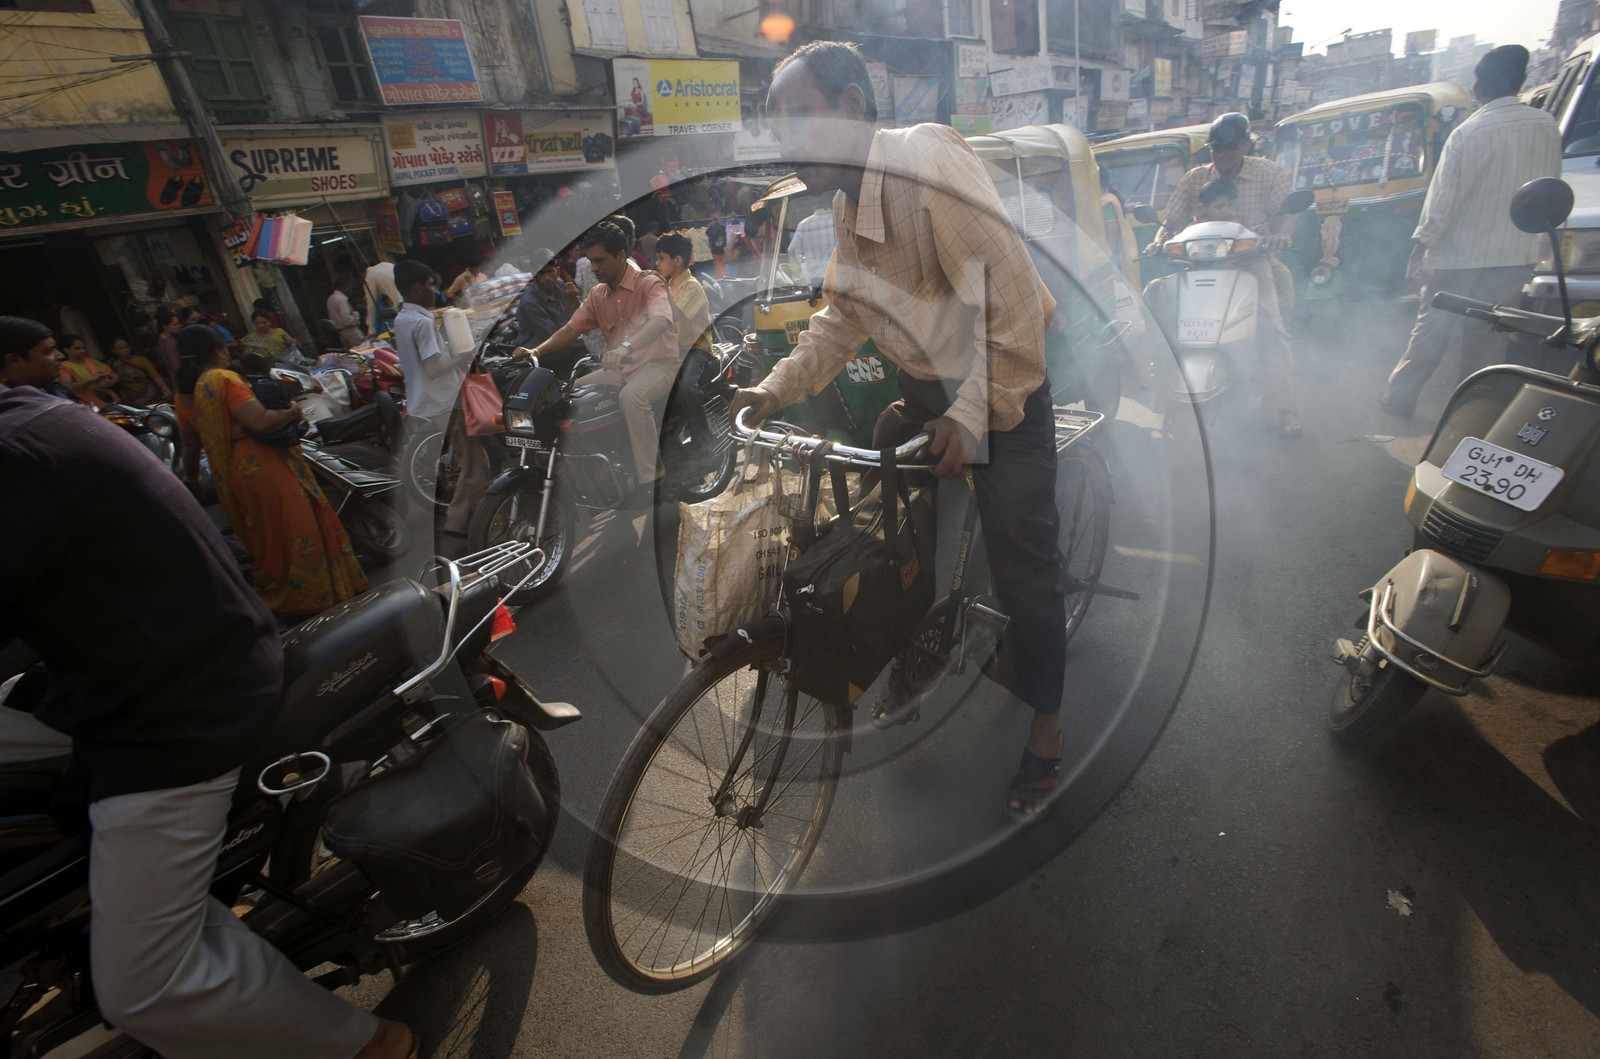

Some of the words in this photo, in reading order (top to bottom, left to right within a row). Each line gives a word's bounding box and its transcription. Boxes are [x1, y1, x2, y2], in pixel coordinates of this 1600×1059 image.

[675, 79, 738, 97] Aristocrat
[668, 124, 698, 134] TRAVEL
[701, 123, 733, 133] CORNER
[392, 151, 428, 169] ગોપાલ
[491, 145, 525, 163] VIP
[41, 151, 131, 188] ग्रीन
[229, 146, 340, 193] SUPREME
[311, 174, 357, 192] SHOES
[846, 355, 885, 383] CNG
[1516, 422, 1549, 446] bajaj
[754, 528, 768, 540] ISO
[755, 547, 782, 560] OHSAS
[758, 563, 782, 581] GAIL
